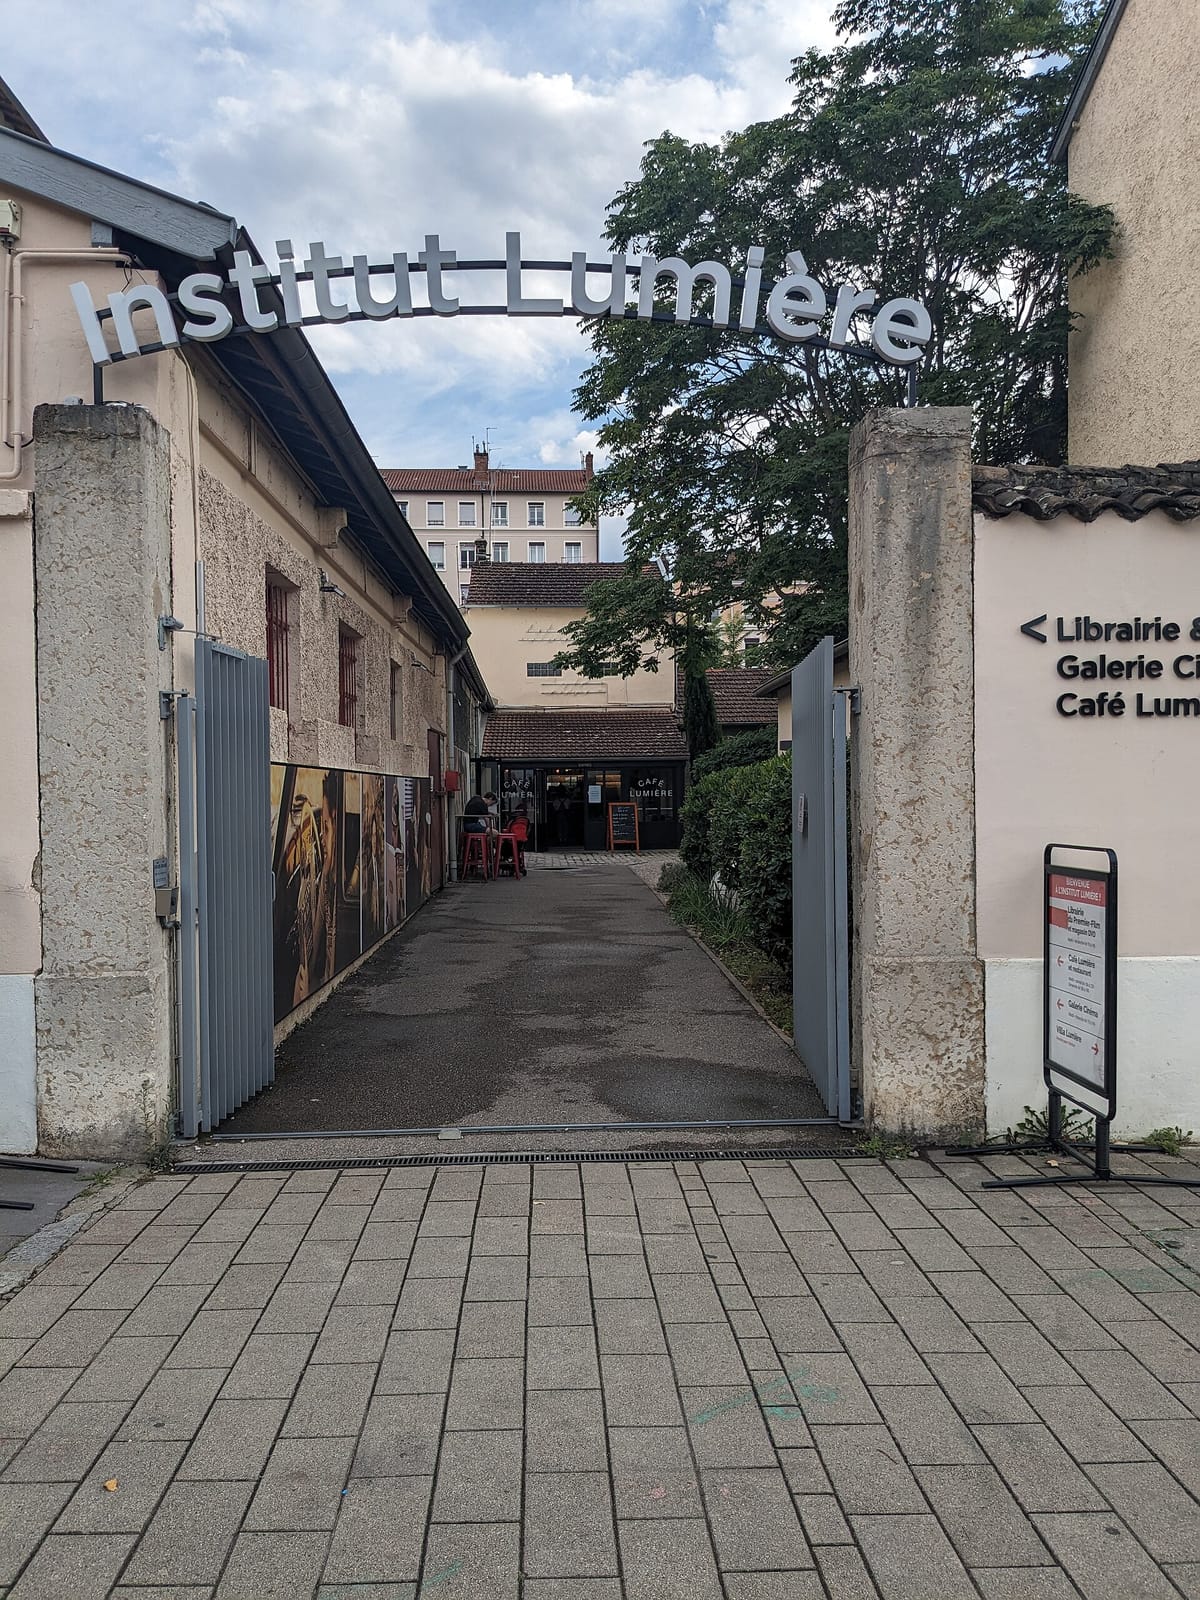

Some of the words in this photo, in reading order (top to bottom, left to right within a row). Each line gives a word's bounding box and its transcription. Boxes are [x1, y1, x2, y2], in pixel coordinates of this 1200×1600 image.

[68, 234, 460, 367] Institut
[505, 231, 932, 365] Lumière
[1056, 615, 1181, 642] Librairie
[1056, 653, 1164, 680] Galerie
[1056, 690, 1126, 717] Café
[629, 788, 673, 798] LUMIÈRE
